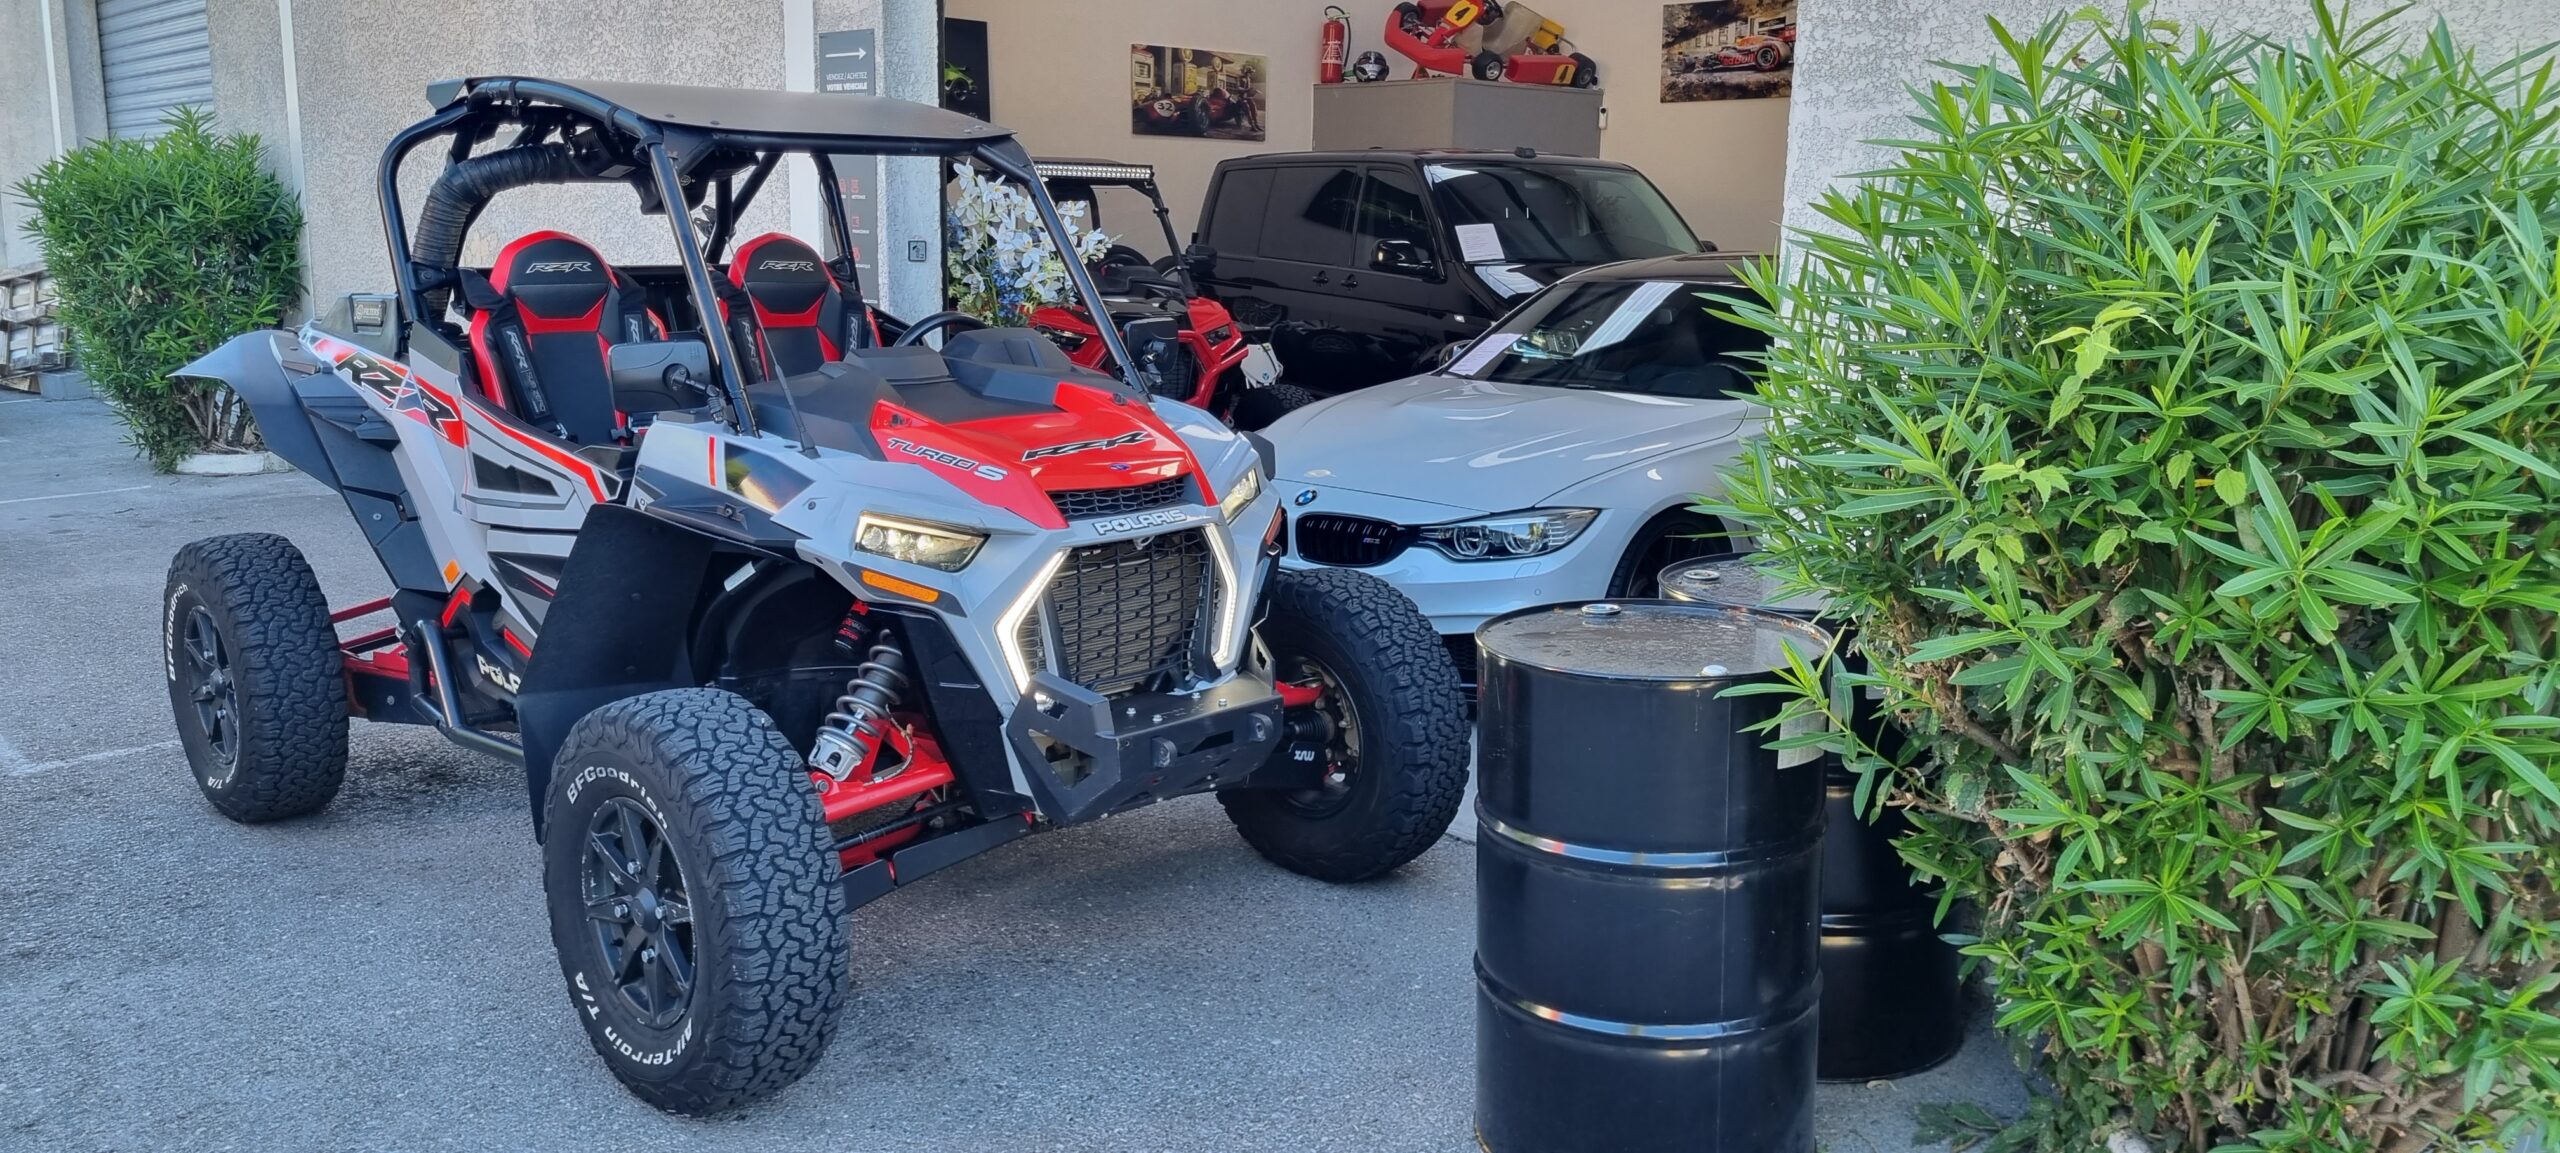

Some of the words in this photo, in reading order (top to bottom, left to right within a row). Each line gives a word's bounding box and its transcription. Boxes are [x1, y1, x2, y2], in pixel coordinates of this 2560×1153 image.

[1455, 6, 1470, 21] 4
[826, 83, 843, 91] VOTRE
[1558, 65, 1570, 83] 4
[1157, 102, 1173, 111] 32
[525, 261, 593, 274] RZR
[759, 260, 815, 272] RZR
[506, 331, 528, 369] RZR
[335, 351, 460, 440] RZR
[887, 438, 977, 470] TURBO
[974, 465, 1008, 481] S
[1021, 431, 1150, 462] RZR
[1093, 509, 1187, 536] POLARIS
[166, 582, 189, 681] BFGoodrich
[566, 765, 668, 830] BFGoodrich
[575, 971, 600, 1020] T/A
